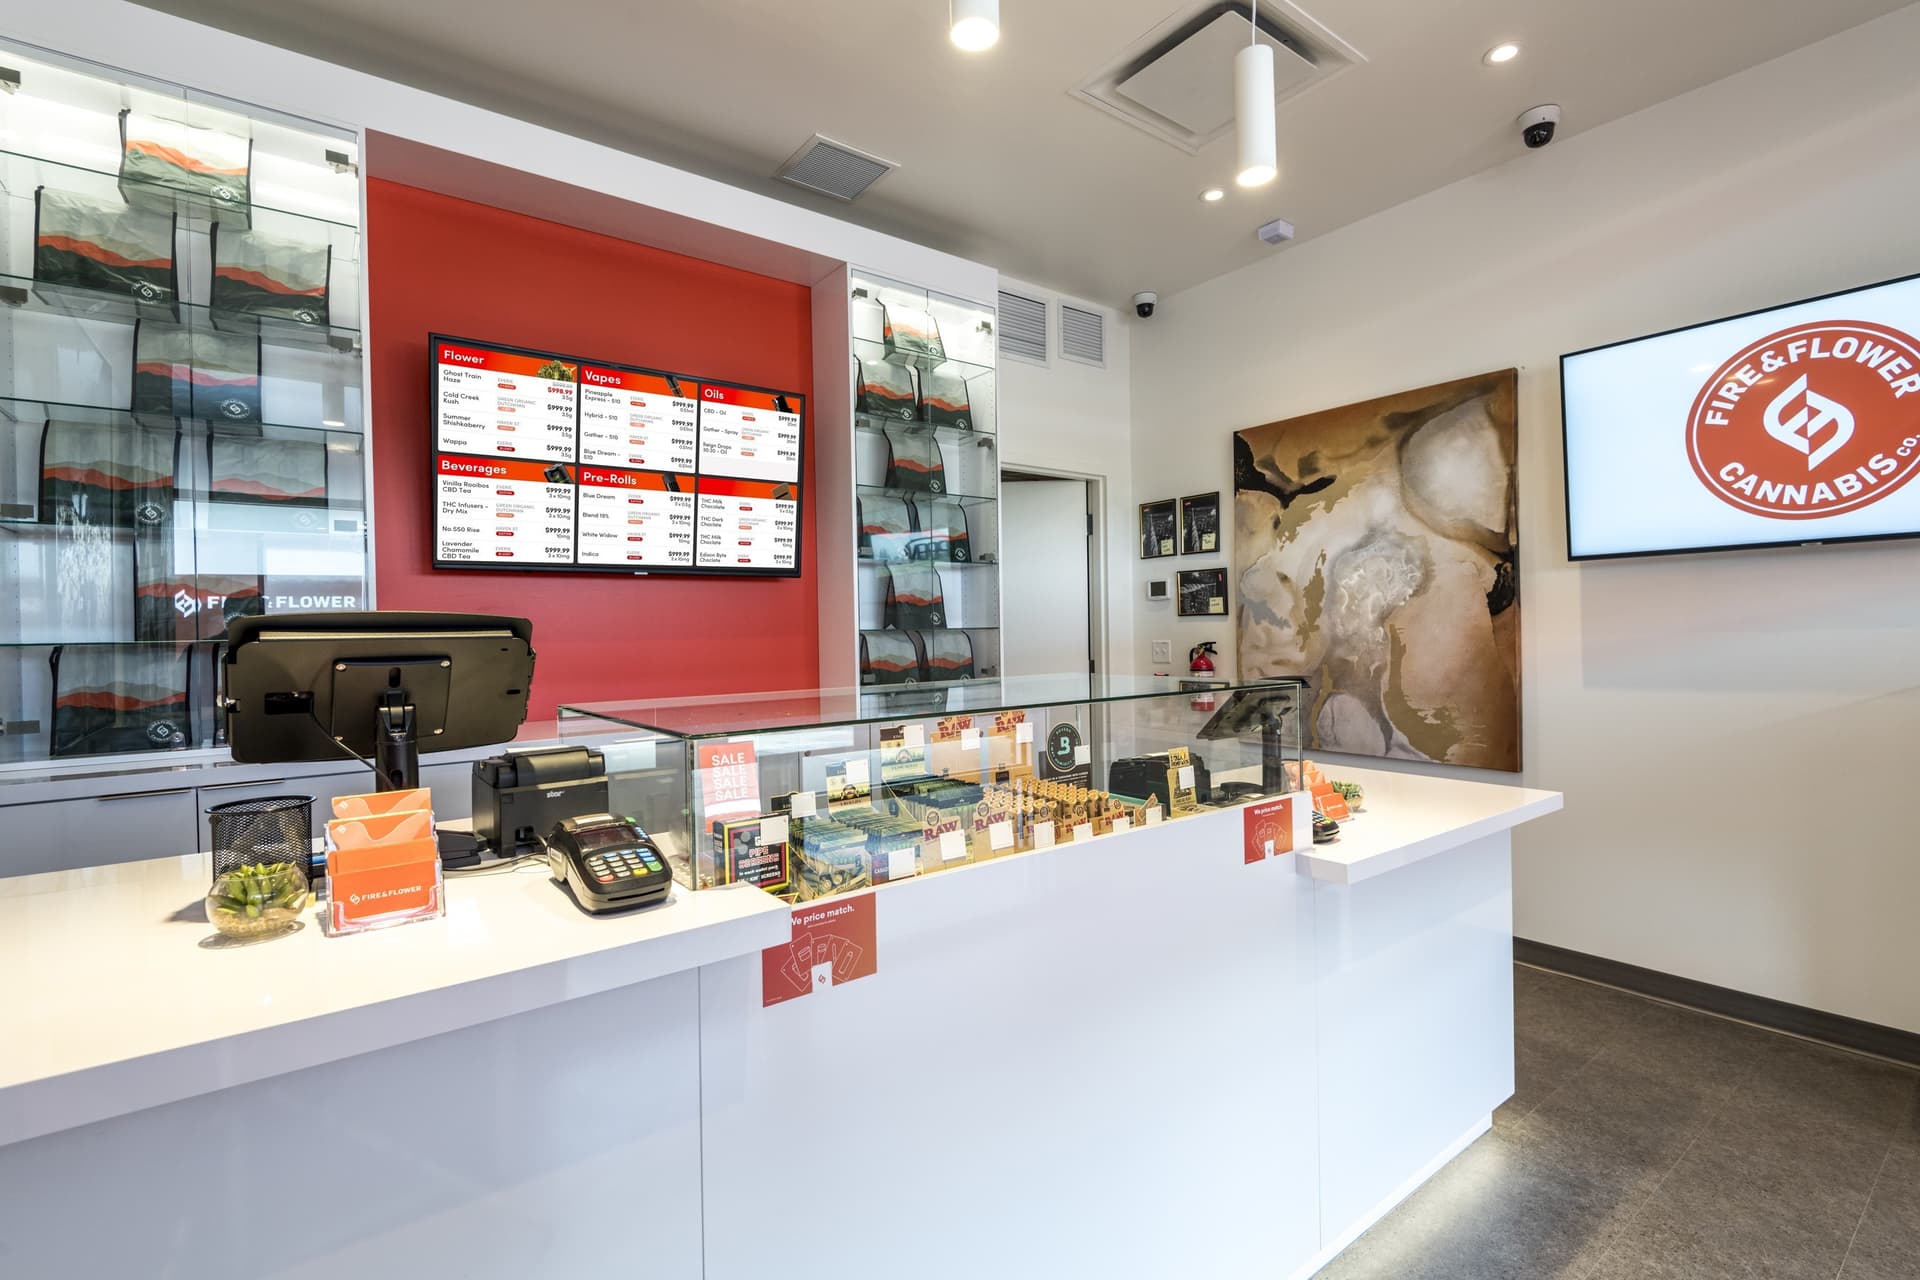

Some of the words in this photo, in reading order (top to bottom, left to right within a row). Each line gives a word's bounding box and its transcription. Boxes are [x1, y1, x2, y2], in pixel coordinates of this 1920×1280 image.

[444, 349, 485, 364] Flower
[443, 369, 463, 377] Ghost
[465, 372, 482, 380] Train
[585, 370, 621, 385] Vapes
[547, 386, 573, 395] $998.99
[584, 388, 613, 397] Pineapple
[704, 388, 725, 400] Oils
[584, 394, 606, 403] Express
[547, 403, 573, 412] $999.99
[672, 400, 694, 408] $999.99
[443, 413, 471, 421] Summer
[584, 411, 604, 420] Hybrid
[443, 419, 486, 430] Shishkaberry
[546, 423, 572, 432] $999.99
[671, 419, 694, 428] $999.99
[724, 428, 739, 436] Spray
[443, 437, 467, 446] Wappa
[671, 438, 693, 446] $999.99
[546, 444, 572, 452] $999.99
[670, 456, 692, 464] $999.99
[441, 459, 508, 476] Beverages
[583, 471, 637, 485] Pre-Rolls
[1719, 453, 1898, 505] CANNABIS
[463, 481, 490, 489] Rooibos
[546, 486, 571, 494] $999.99
[442, 507, 454, 515] Dry
[545, 506, 571, 514] $999.99
[545, 526, 571, 534] $999.99
[544, 546, 570, 554] $999.99
[996, 714, 1026, 733] RAW
[939, 719, 973, 739] RAW
[711, 752, 745, 766] SALE
[713, 765, 745, 778] SALE
[713, 776, 747, 790] SALE
[714, 787, 747, 801] SALE
[975, 812, 1005, 832] RAW
[1105, 811, 1124, 826] RAW
[1065, 817, 1087, 834] RAW
[924, 821, 958, 842] RAW
[361, 885, 422, 901] FIRE&FLOWER
[803, 911, 826, 926] price
[827, 904, 855, 917] match.
